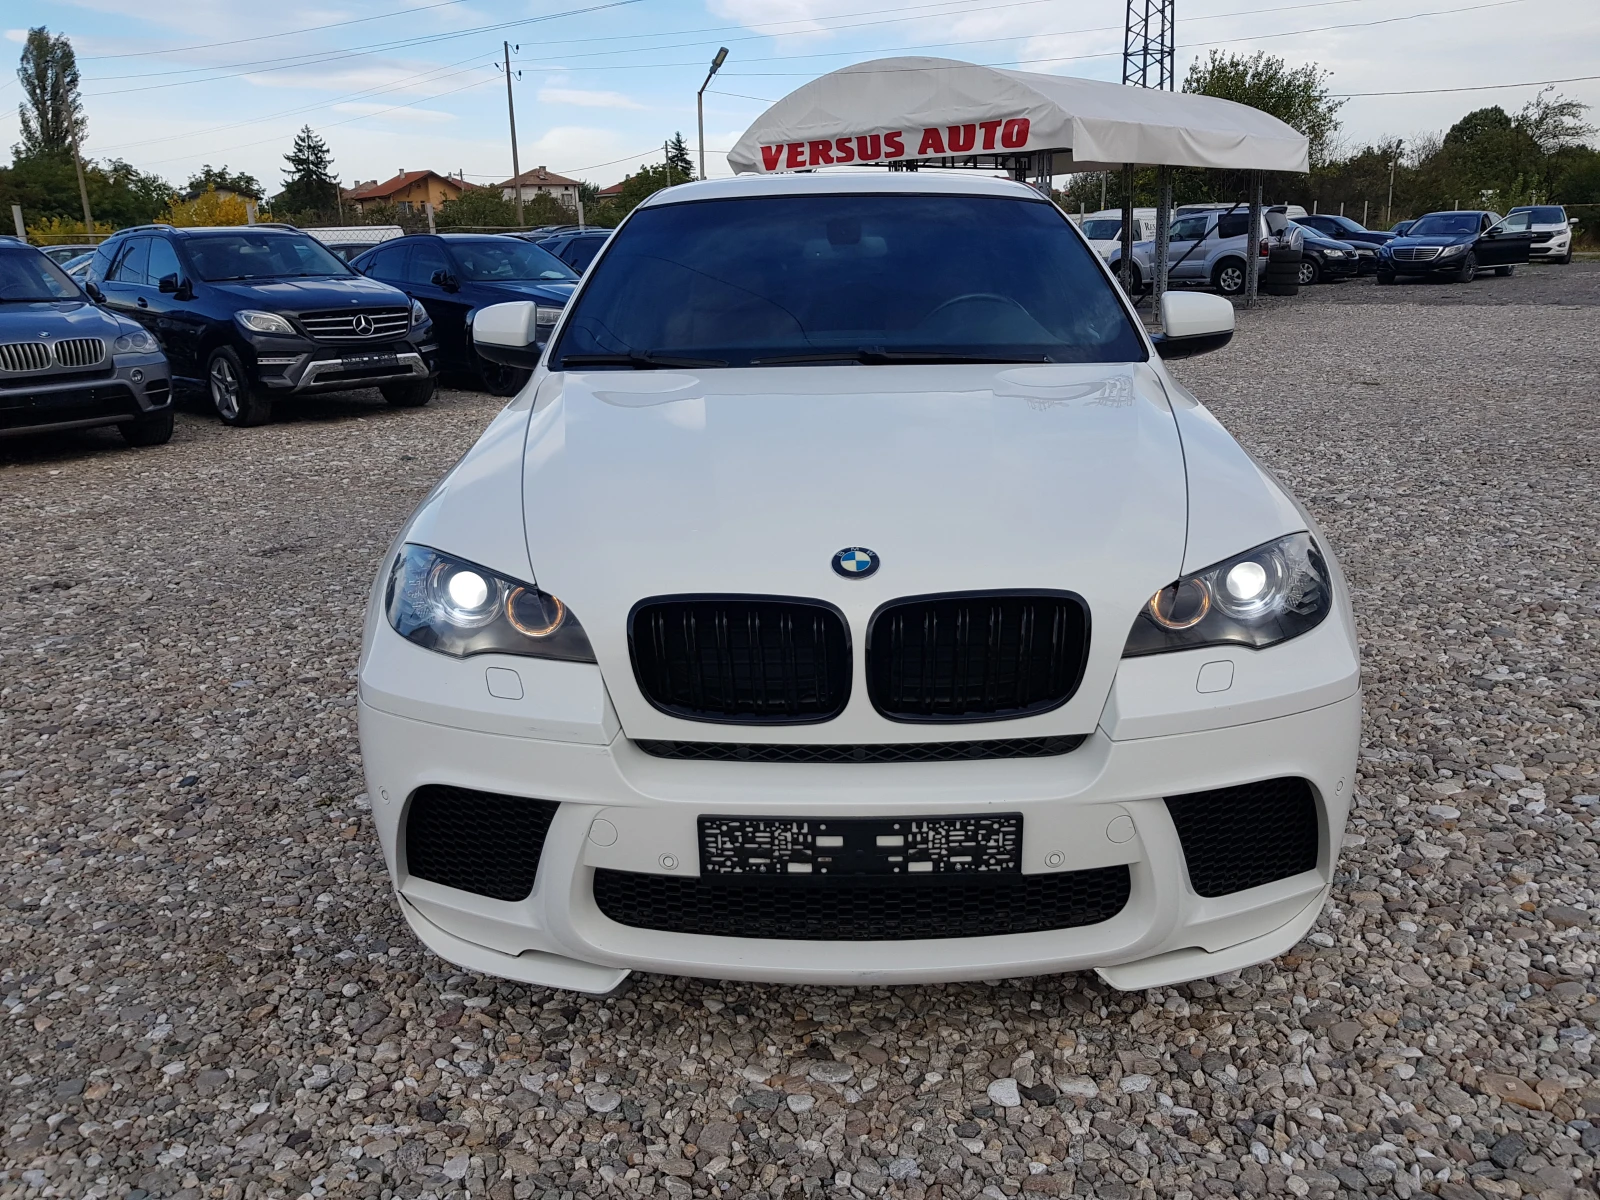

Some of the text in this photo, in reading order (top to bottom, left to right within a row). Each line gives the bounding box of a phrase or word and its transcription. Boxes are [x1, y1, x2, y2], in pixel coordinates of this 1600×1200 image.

[760, 118, 1030, 171] VERSUS AUTO
[836, 547, 876, 557] BMW
